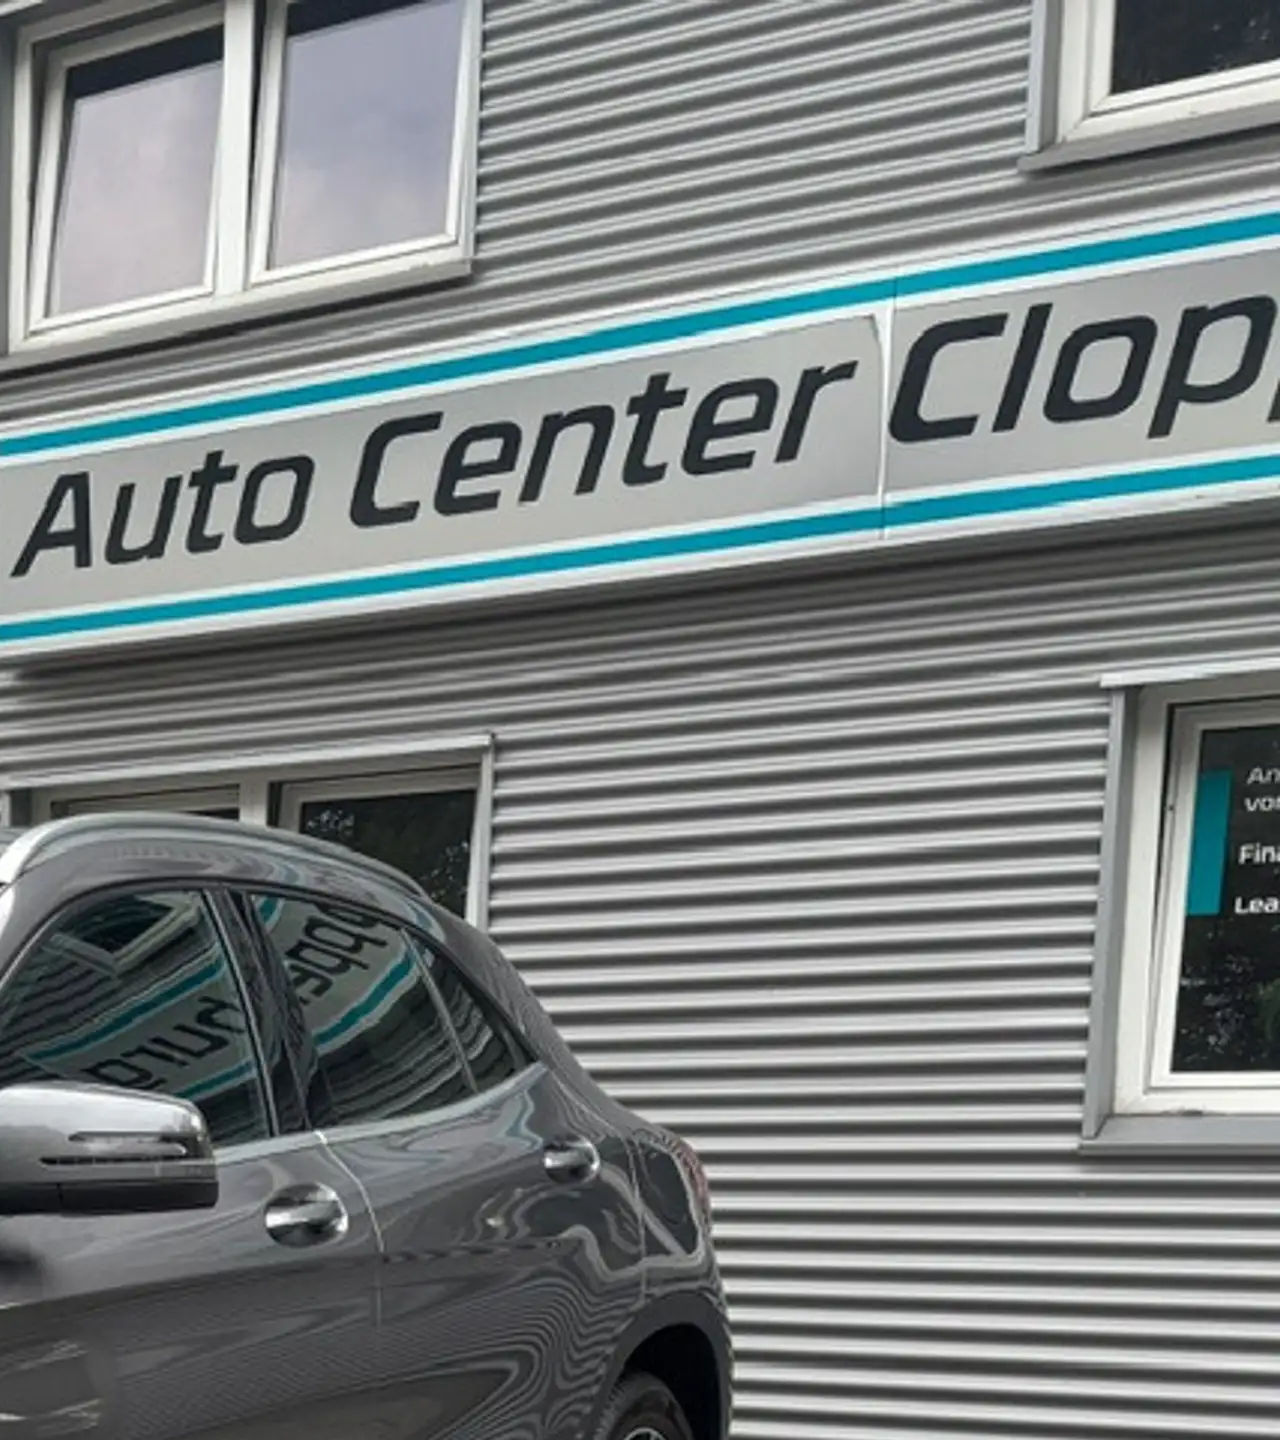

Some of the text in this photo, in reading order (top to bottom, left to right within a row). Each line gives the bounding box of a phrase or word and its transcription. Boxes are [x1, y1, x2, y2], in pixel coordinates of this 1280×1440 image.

[11, 295, 1280, 577] Auto Center Clop
[1244, 796, 1280, 812] vo
[1235, 896, 1280, 915] Lea
